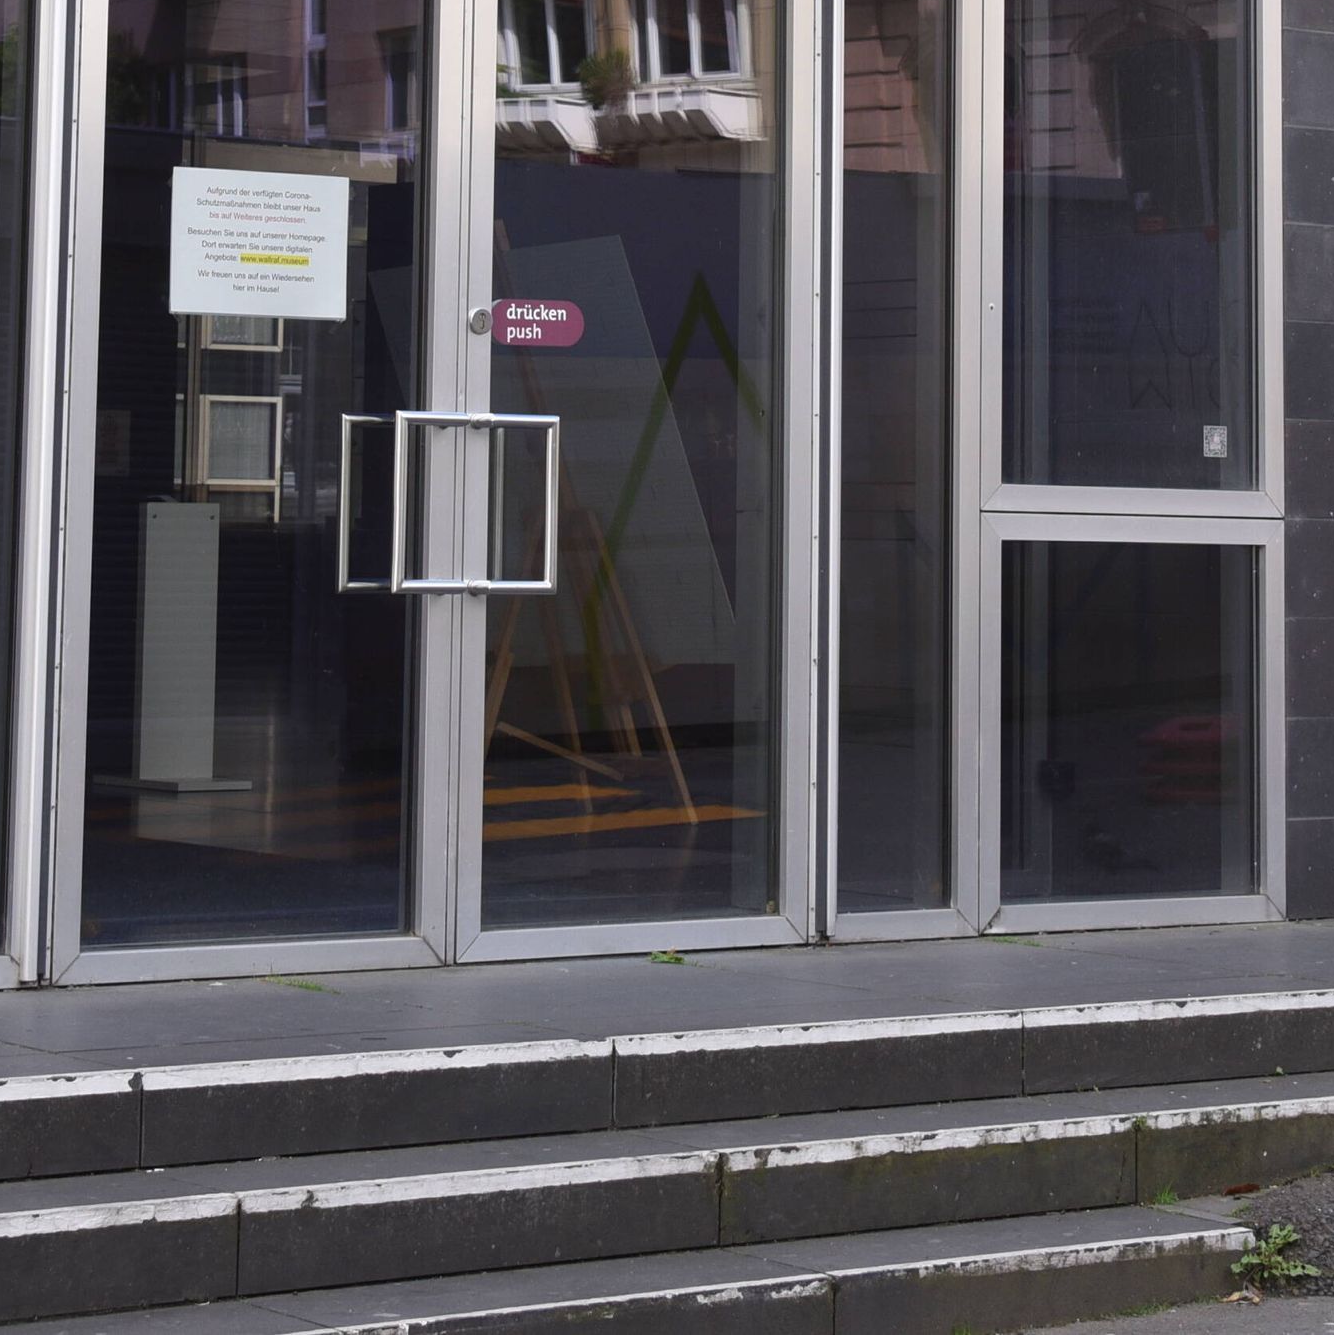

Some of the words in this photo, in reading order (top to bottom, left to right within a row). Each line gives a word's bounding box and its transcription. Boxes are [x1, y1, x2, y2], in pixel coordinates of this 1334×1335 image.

[207, 186, 238, 197] Aufgrund
[239, 188, 250, 196] der
[252, 189, 284, 199] verfügten
[285, 191, 312, 200] Corona-
[196, 198, 262, 209] Schutzmaßnahmen
[263, 201, 281, 210] bleibt
[303, 204, 321, 212] Haus
[209, 211, 219, 219] bis
[233, 212, 263, 221] Weiteres
[187, 227, 222, 237] Besuchen
[223, 229, 234, 237] Sie
[250, 230, 261, 238] auf
[262, 232, 287, 240] unserer
[201, 240, 217, 248] Dort
[218, 241, 247, 250] erwarten
[248, 243, 259, 251] Sie
[261, 244, 284, 252] unsere
[285, 245, 313, 254] digitalen
[197, 269, 210, 278] Wir
[211, 271, 233, 279] freuen
[247, 272, 258, 280] auf
[271, 274, 315, 283] Wiedersehen
[246, 284, 256, 292] im
[256, 284, 280, 293] Hause!
[506, 303, 567, 321] drücken
[506, 323, 542, 343] push
